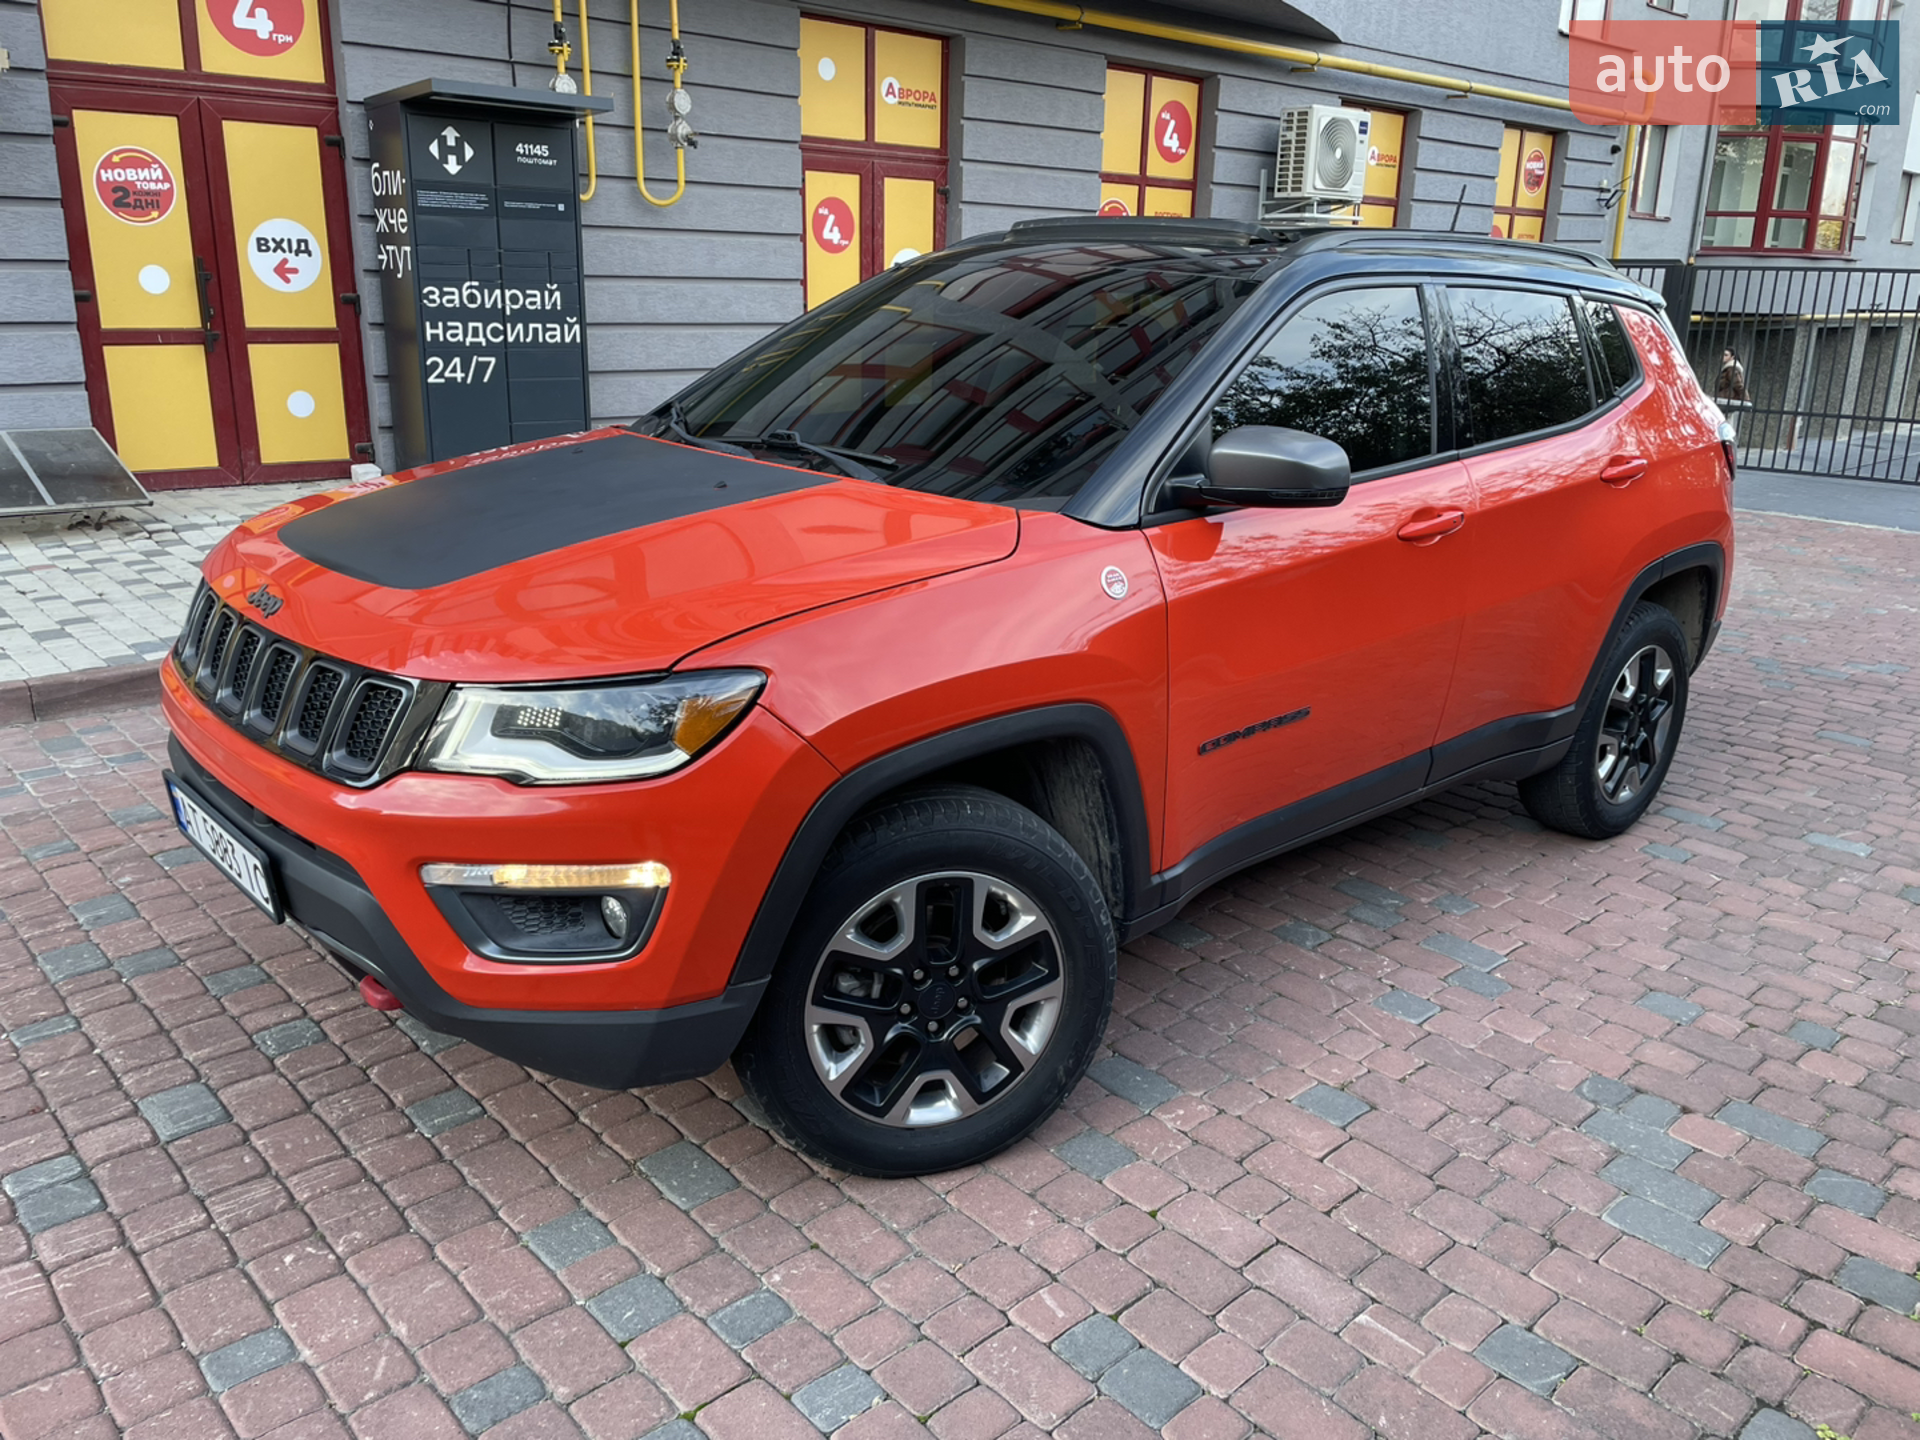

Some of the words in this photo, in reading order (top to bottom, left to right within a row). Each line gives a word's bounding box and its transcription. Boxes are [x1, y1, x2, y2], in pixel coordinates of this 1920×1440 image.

[233, 0, 274, 39] 4
[272, 33, 293, 44] грн
[515, 143, 549, 157] 41145
[1163, 119, 1179, 152] 4
[100, 164, 163, 182] НОВИЙ
[134, 181, 171, 190] ТОВАР
[111, 186, 131, 208] 2
[132, 199, 160, 210] ДНІ
[374, 208, 408, 234] жче
[823, 214, 841, 244] 4
[256, 237, 312, 257] ВХІД
[386, 245, 411, 278] тут
[422, 281, 561, 315] забирай
[425, 317, 581, 346] надсилай
[426, 355, 496, 384] 24/7
[248, 584, 284, 619] Jeep
